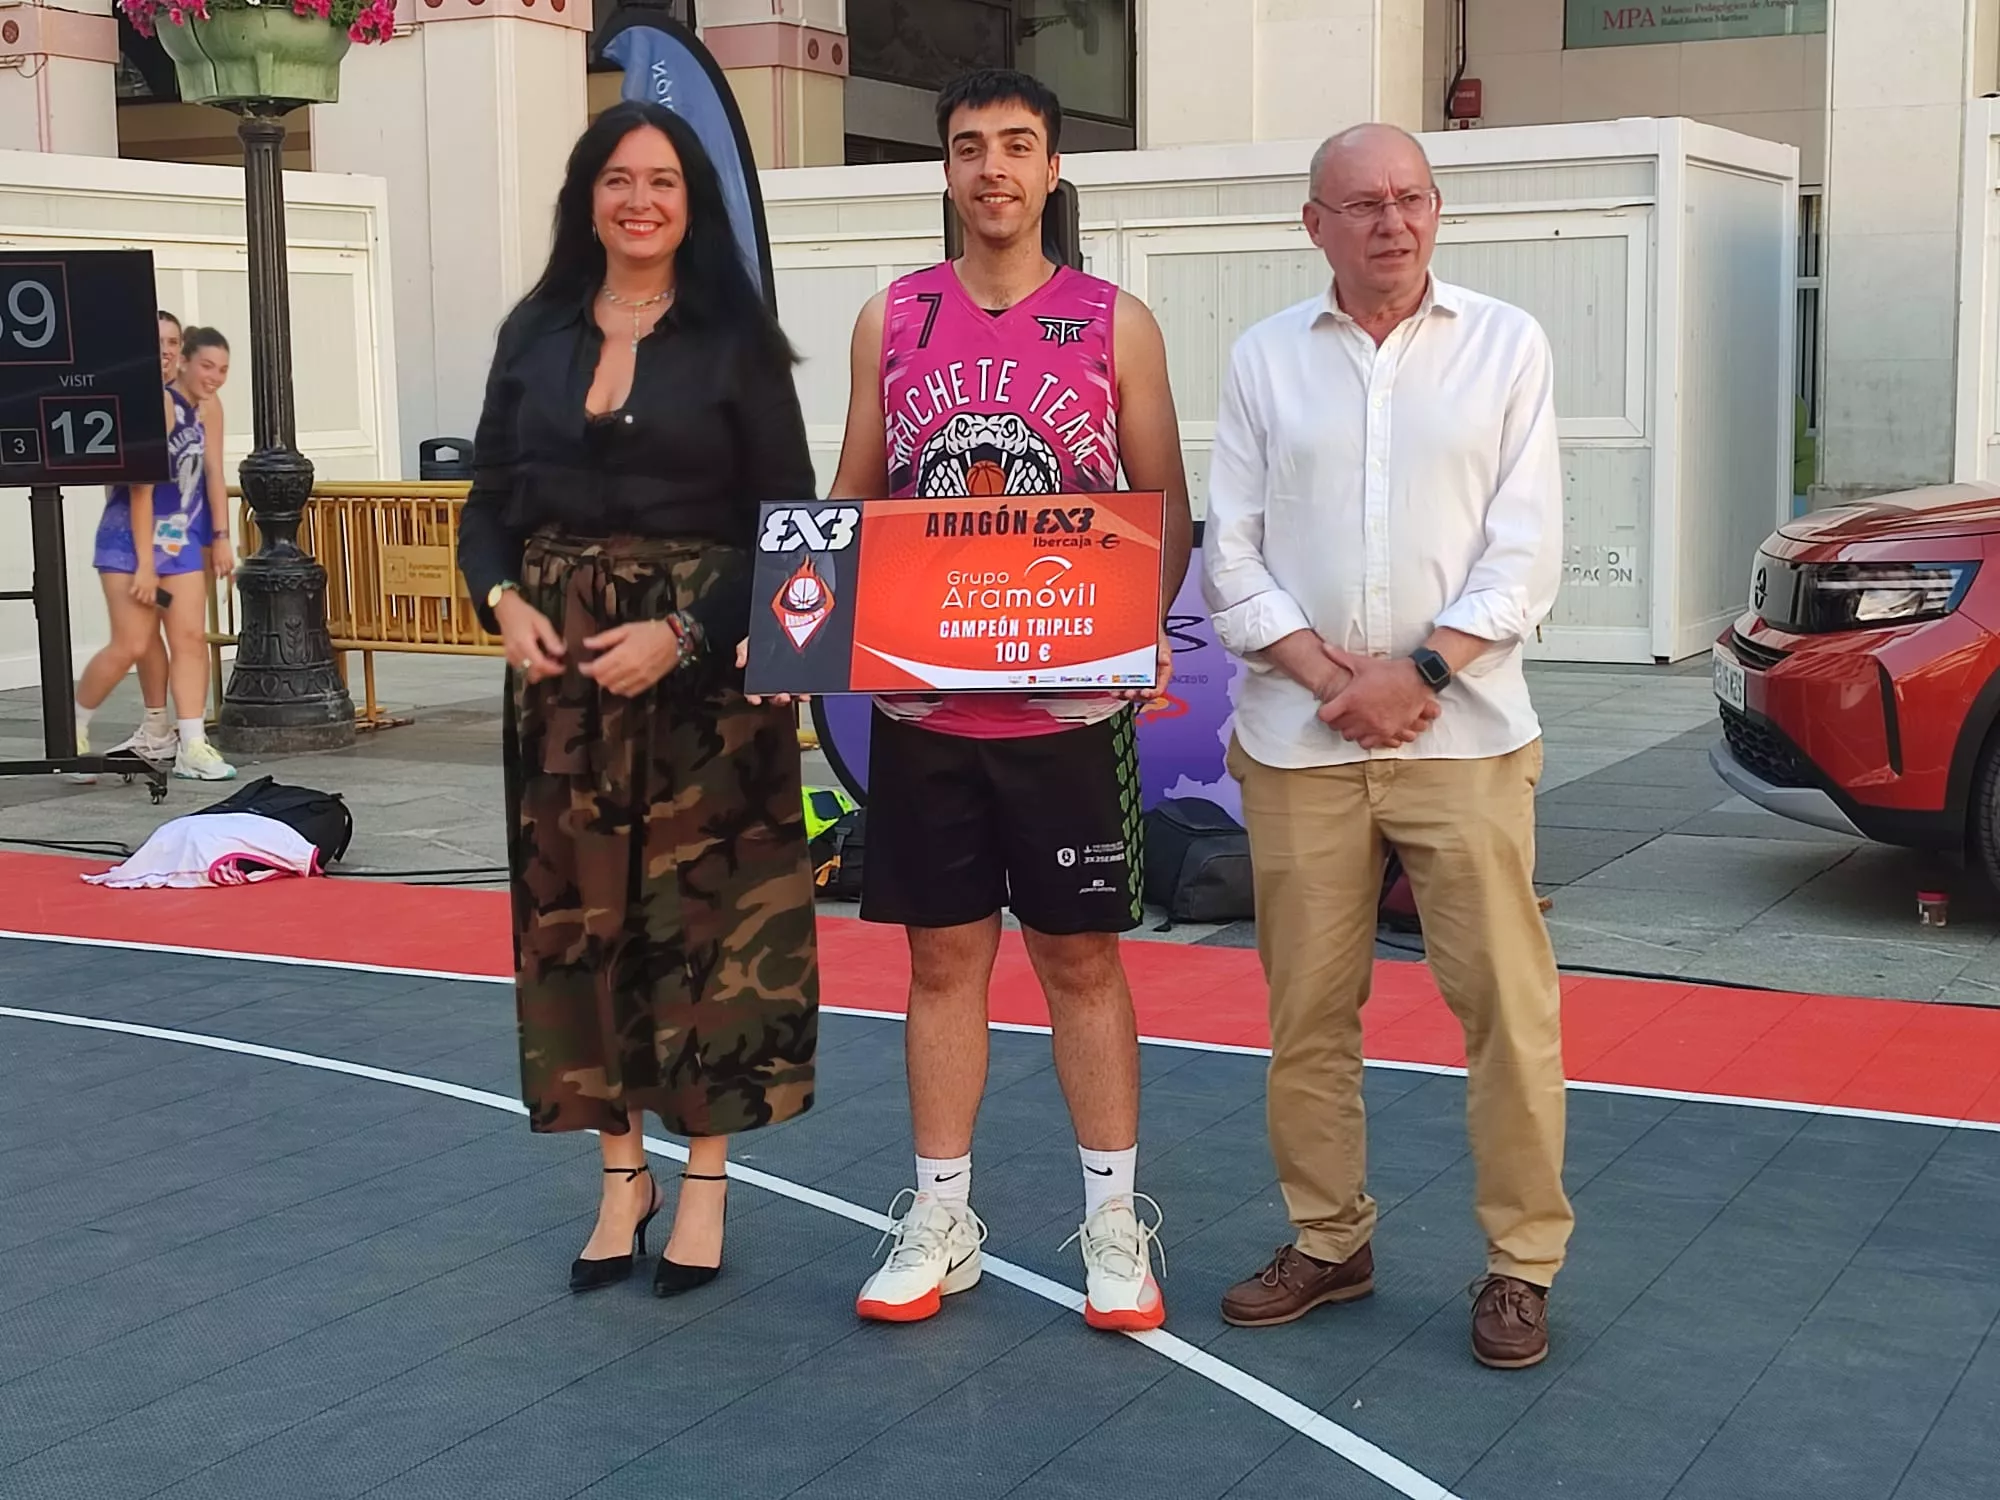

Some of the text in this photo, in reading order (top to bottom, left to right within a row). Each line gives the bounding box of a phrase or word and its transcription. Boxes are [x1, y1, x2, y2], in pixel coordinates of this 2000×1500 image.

[1603, 8, 1656, 30] MPA
[916, 292, 943, 349] 7
[59, 374, 95, 387] VISIT
[1028, 372, 1099, 466] TEAM
[13, 410, 116, 455] 3 12
[925, 504, 1028, 537] ARAGÓN
[1033, 536, 1092, 549] Ibercaja
[946, 570, 1010, 586] Grupo
[939, 616, 1095, 639] CAMPEÓN TRIPLES
[995, 642, 1052, 664] 100 €
